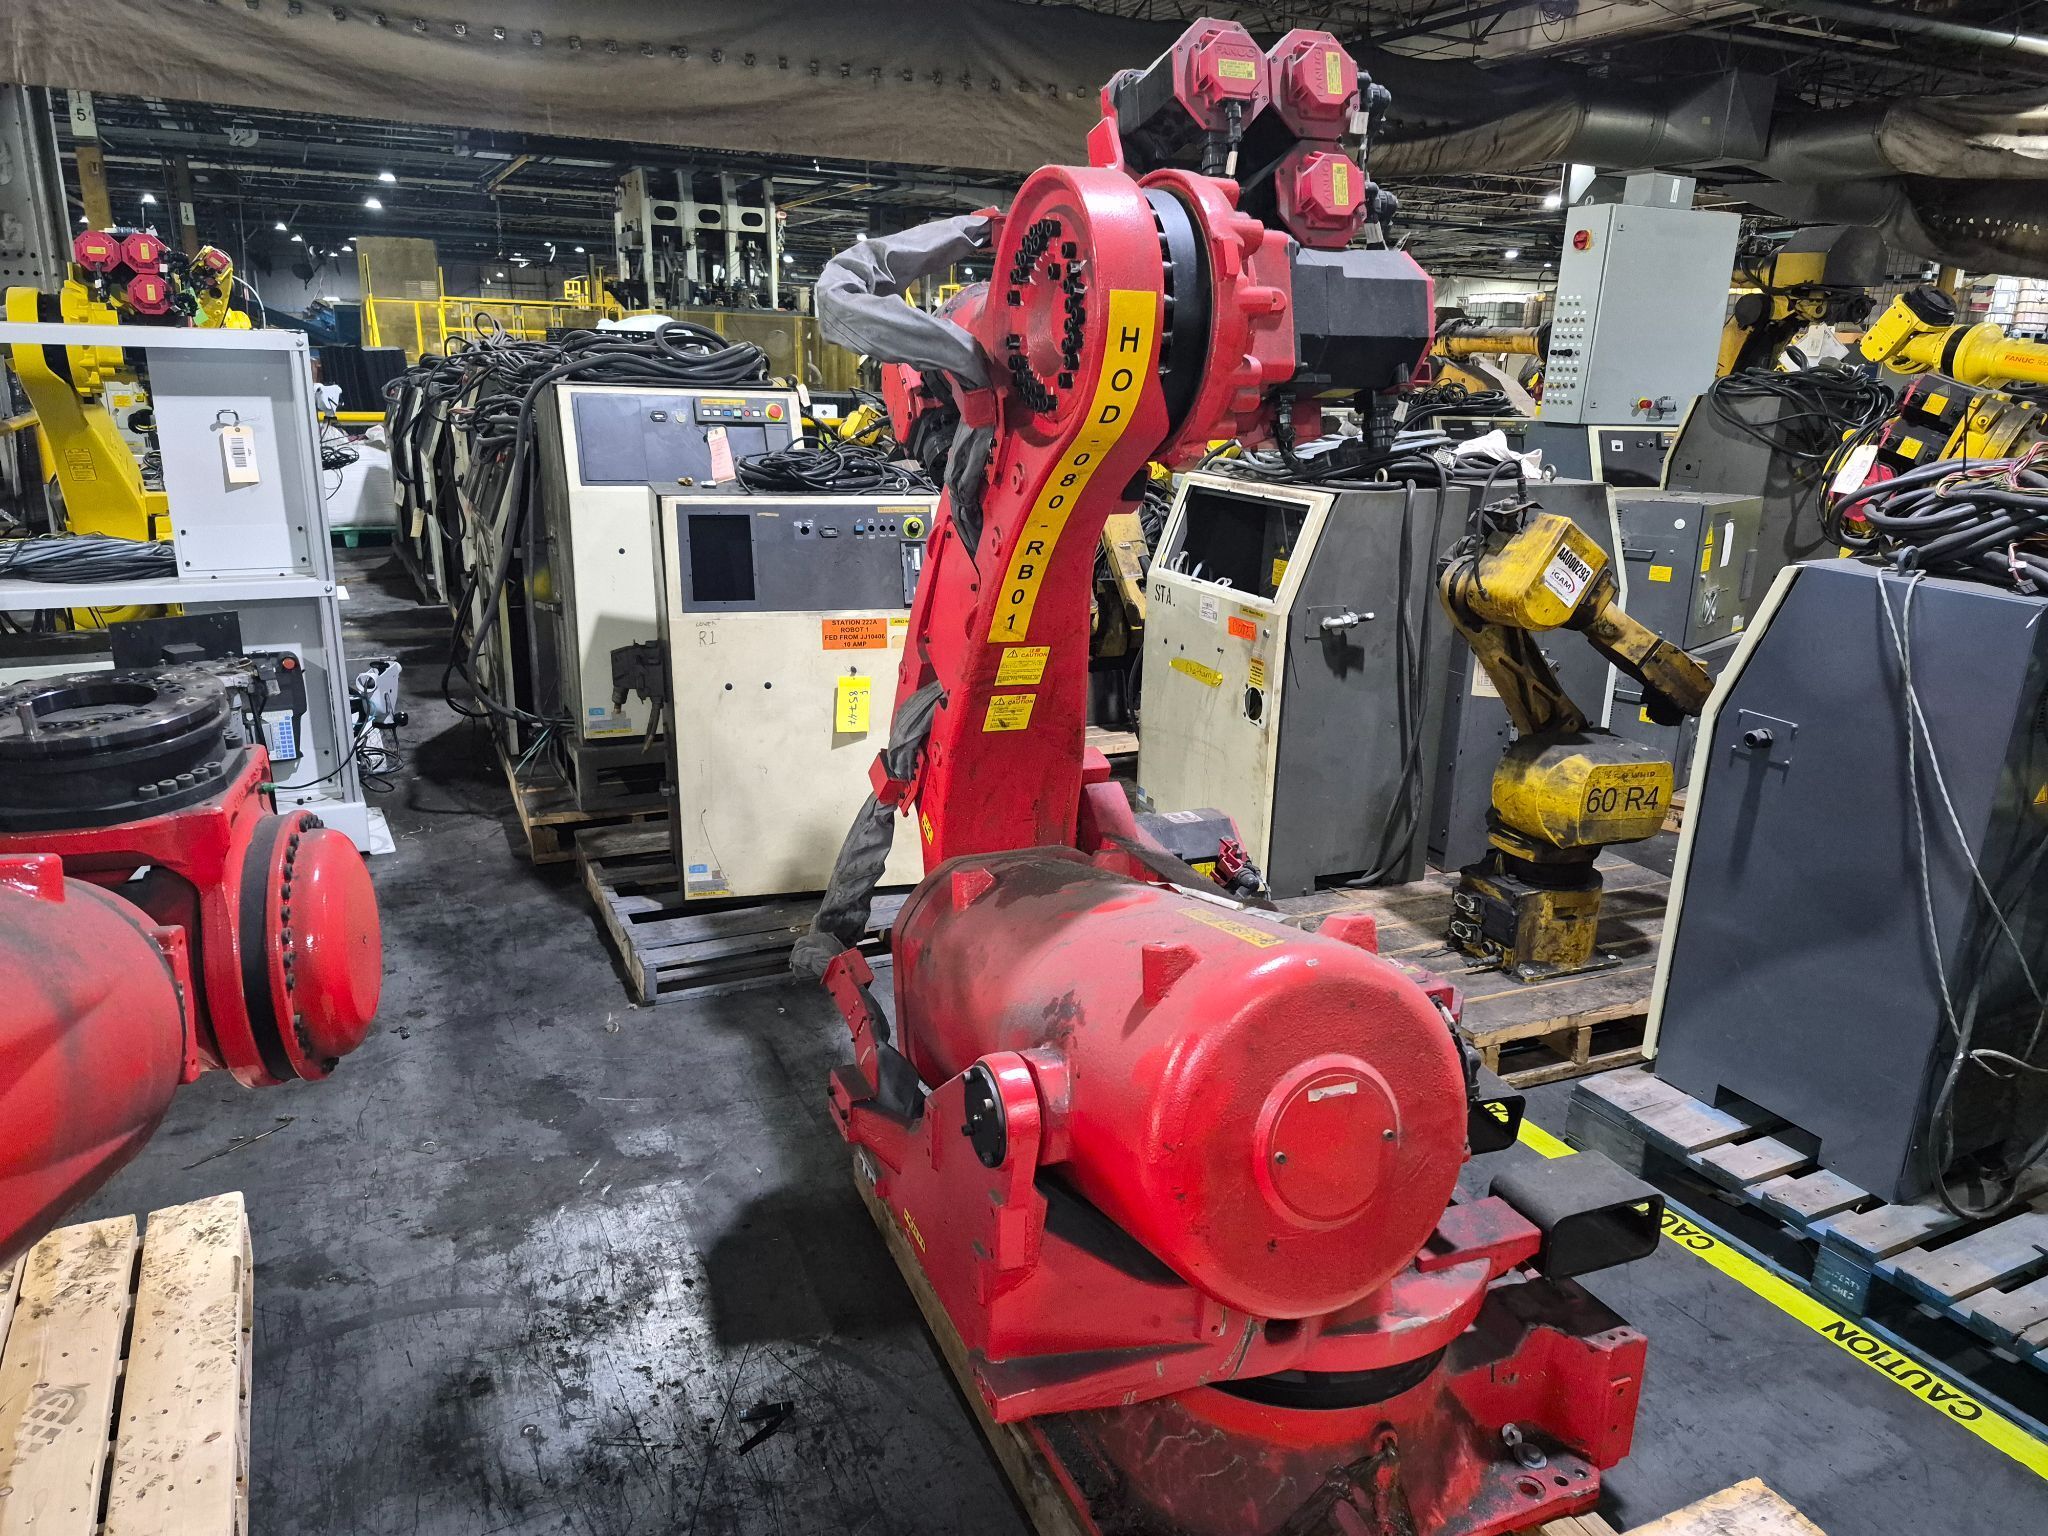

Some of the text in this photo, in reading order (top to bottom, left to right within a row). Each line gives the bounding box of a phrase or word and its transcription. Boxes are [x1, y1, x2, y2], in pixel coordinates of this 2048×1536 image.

[2004, 354, 2034, 364] FANUC
[1557, 547, 1590, 582] AA000293
[1155, 584, 1176, 607] STA.
[1586, 785, 1659, 813] 60 R4
[1821, 1320, 1983, 1420] CAUTION
